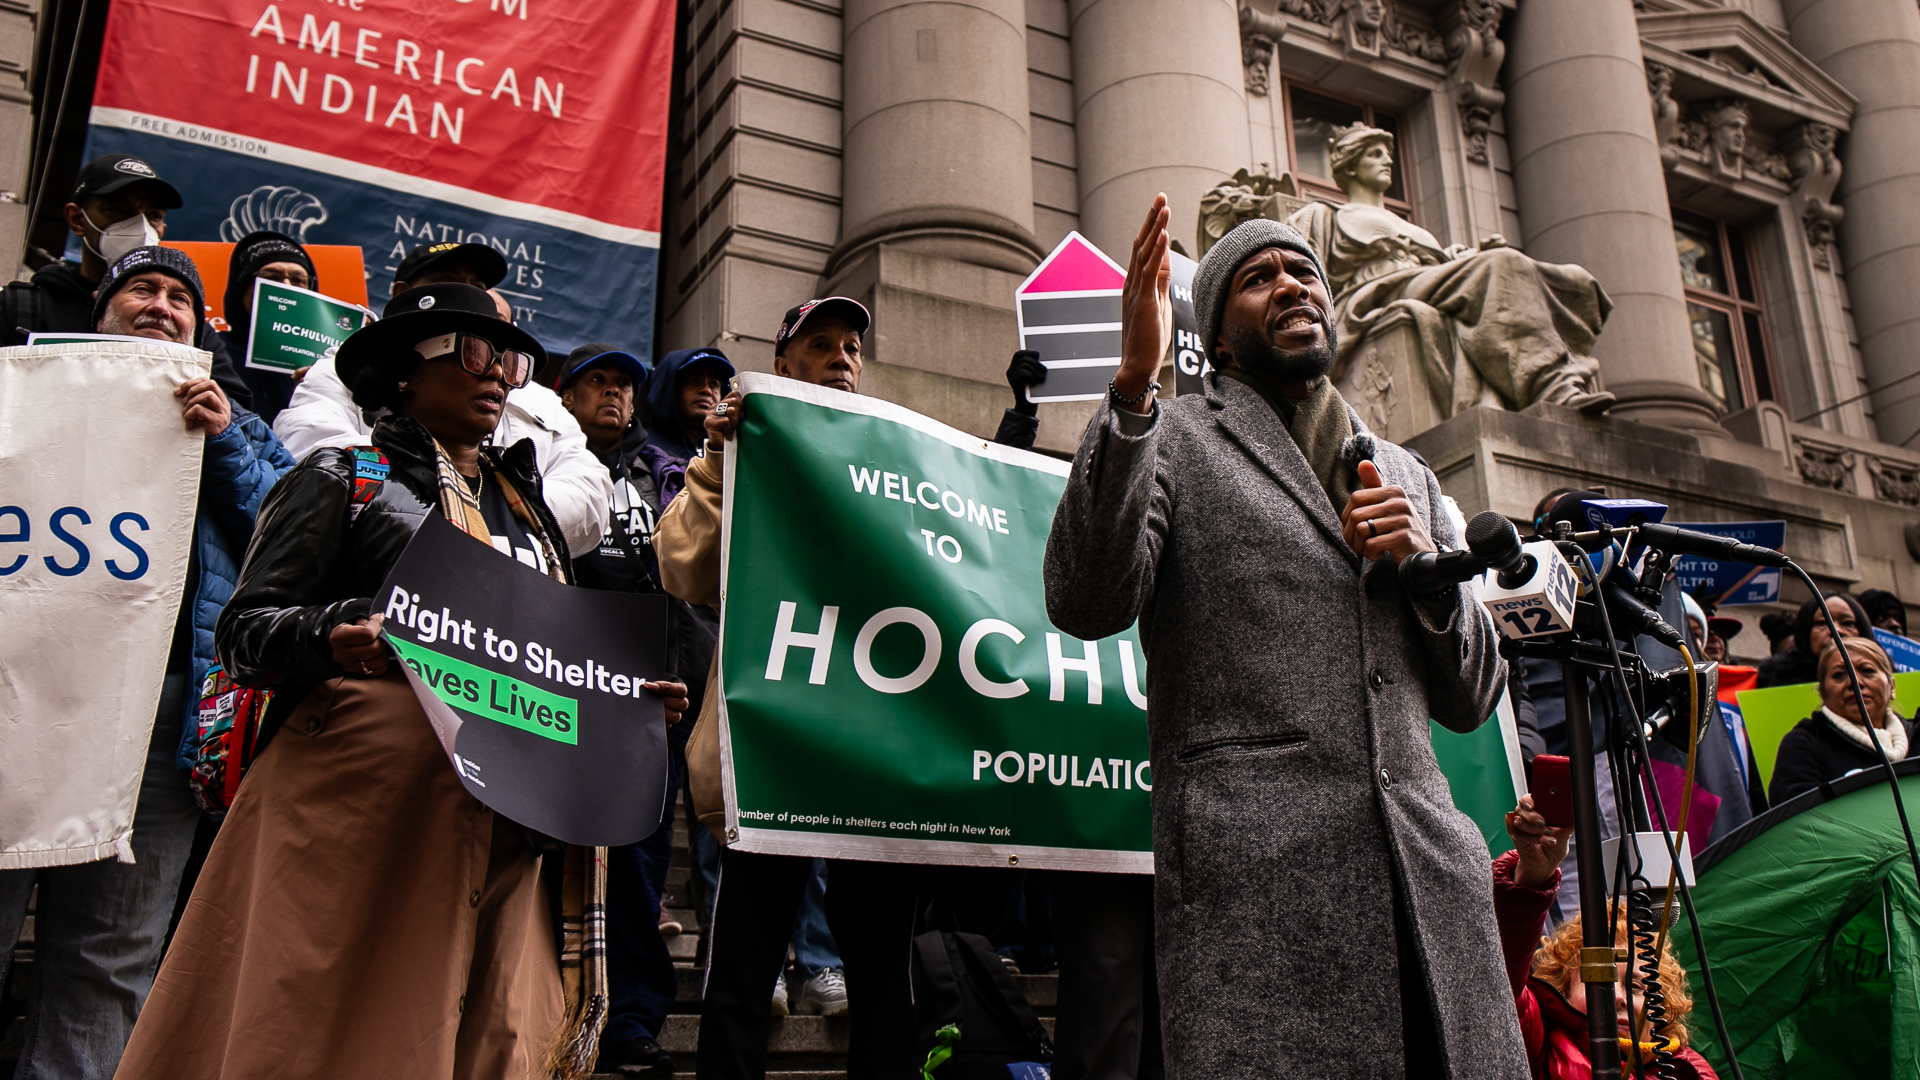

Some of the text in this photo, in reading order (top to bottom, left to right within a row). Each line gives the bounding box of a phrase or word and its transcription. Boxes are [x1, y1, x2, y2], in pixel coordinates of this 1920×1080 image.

[250, 4, 564, 118] AMERICAN
[246, 54, 464, 144] INDIAN
[131, 115, 268, 155] FREE ADMISSION
[268, 294, 297, 306] WELCOME
[848, 464, 1010, 535] WELCOME
[920, 528, 963, 564] TO
[1546, 551, 1559, 596] news
[1678, 576, 1715, 587] ELTR
[1701, 561, 1719, 572] TO
[1493, 597, 1543, 612] news
[1555, 562, 1577, 616] 12
[1502, 607, 1563, 635] 12
[385, 585, 646, 698] Right to Shelter
[390, 642, 572, 733] aves Lives
[777, 811, 789, 822] of
[790, 814, 830, 826] people
[832, 815, 842, 825] in
[845, 816, 886, 829] shelters
[889, 820, 917, 831] each
[920, 821, 947, 834] night
[949, 823, 959, 833] in
[962, 824, 986, 835] New
[989, 825, 1011, 836] York
